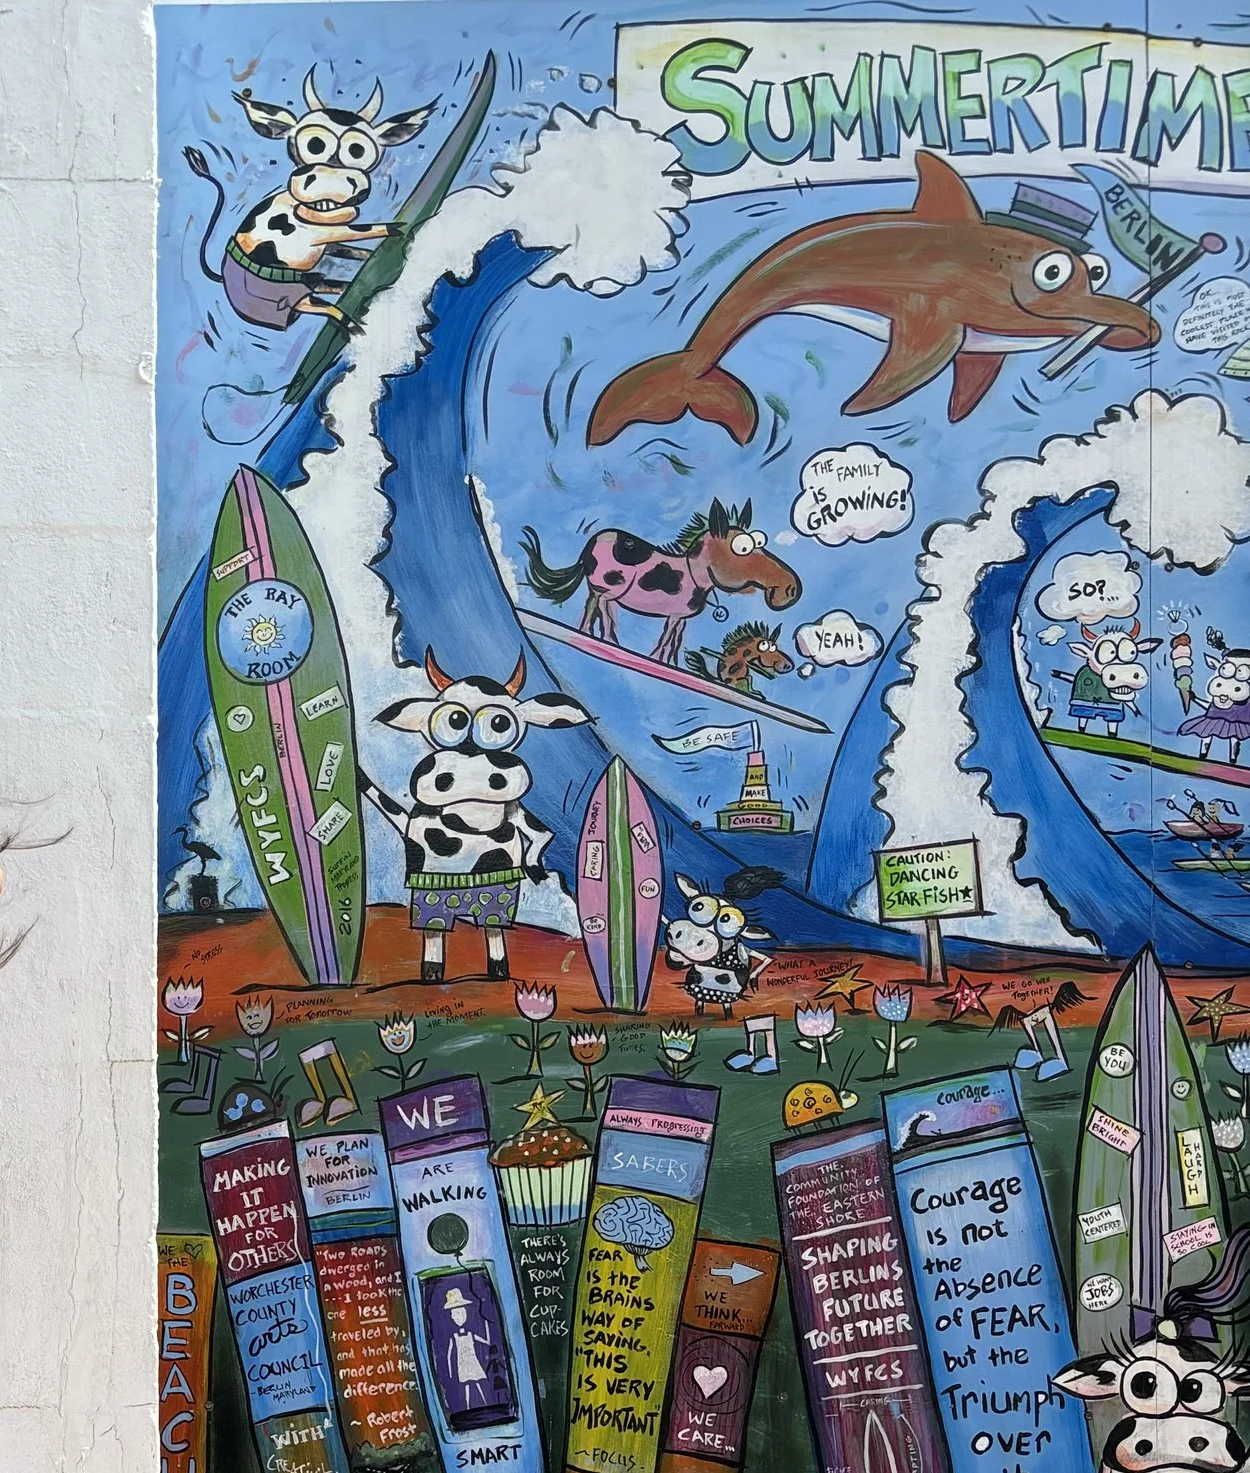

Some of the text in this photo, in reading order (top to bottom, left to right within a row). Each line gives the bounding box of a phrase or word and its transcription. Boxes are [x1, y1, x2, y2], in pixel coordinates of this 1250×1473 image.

[661, 38, 1250, 173] SUMMERTIME
[1105, 182, 1185, 272] BERLIN
[811, 458, 883, 482] THE FAMILY
[224, 588, 303, 619] THE RAY
[814, 628, 864, 653] YEAH!
[244, 650, 303, 679] ROOM
[304, 695, 338, 717] LEARN
[273, 722, 286, 758] BERLIN
[681, 731, 740, 748] BE SAFE
[320, 750, 339, 787] LOVE
[318, 810, 346, 842] SHARE
[733, 815, 773, 826] CHOICES
[640, 884, 656, 893] FUN
[890, 865, 959, 888] DANCING
[338, 897, 353, 936] 2016
[1001, 980, 1017, 991] WE
[1104, 1055, 1128, 1072] YOU
[1110, 1047, 1127, 1058] BE
[396, 1093, 460, 1131] WE
[609, 1114, 643, 1128] ALWAYS
[1090, 1122, 1128, 1148] BRIGHT
[1097, 1115, 1130, 1138] SHINE
[305, 1137, 369, 1159] WE PLAN
[324, 1154, 351, 1169] FOR
[422, 1162, 455, 1181] ARE
[612, 1151, 690, 1183] SABERS
[1181, 1135, 1200, 1197] LAUGH
[786, 1166, 858, 1195] COMMUNITY
[787, 1175, 881, 1210] FOUNDATION OF
[240, 1186, 265, 1209] IT
[325, 1190, 371, 1206] BERLIN
[401, 1183, 488, 1214] WALKING
[822, 1187, 885, 1214] EASTERN
[910, 1175, 1023, 1215] Courage
[216, 1200, 296, 1237] HAPPEN
[815, 1208, 867, 1231] SHORE
[1081, 1209, 1112, 1227] YOUTH
[1084, 1218, 1123, 1238] CENTERED
[244, 1225, 279, 1245] FOR
[520, 1233, 568, 1250] THERE'S
[159, 1245, 175, 1256] WE
[227, 1238, 299, 1272] OTHERS
[520, 1248, 571, 1267] ALWAYS
[588, 1247, 624, 1263] FEAR
[801, 1231, 900, 1271] SHAPING
[165, 1257, 189, 1269] THE
[528, 1266, 566, 1283] ROOM
[922, 1256, 963, 1276] the
[229, 1273, 316, 1305] WORCHESTER
[812, 1258, 905, 1296] BERLINS
[934, 1262, 1044, 1303] Absence
[532, 1284, 565, 1300] FOR
[704, 1290, 728, 1305] WE
[1084, 1281, 1116, 1301] JOBS
[235, 1297, 298, 1327] COUNTY
[357, 1304, 388, 1318] less
[822, 1286, 906, 1322] FUTURE
[530, 1319, 569, 1338] CAKES
[581, 1308, 646, 1331] WAY OF
[934, 1302, 1061, 1341] of FEAR,
[803, 1313, 914, 1352] TOGETHER
[247, 1349, 323, 1383] COUNCIL
[942, 1344, 1030, 1374] but the
[338, 1363, 375, 1380] made
[824, 1359, 904, 1390] WYFCS
[577, 1373, 656, 1401] IS VERY
[940, 1373, 1067, 1428] Triumph
[366, 1404, 415, 1428] Robert
[687, 1409, 718, 1428] WE
[379, 1422, 419, 1445] Frost
[455, 1443, 523, 1469] SMART
